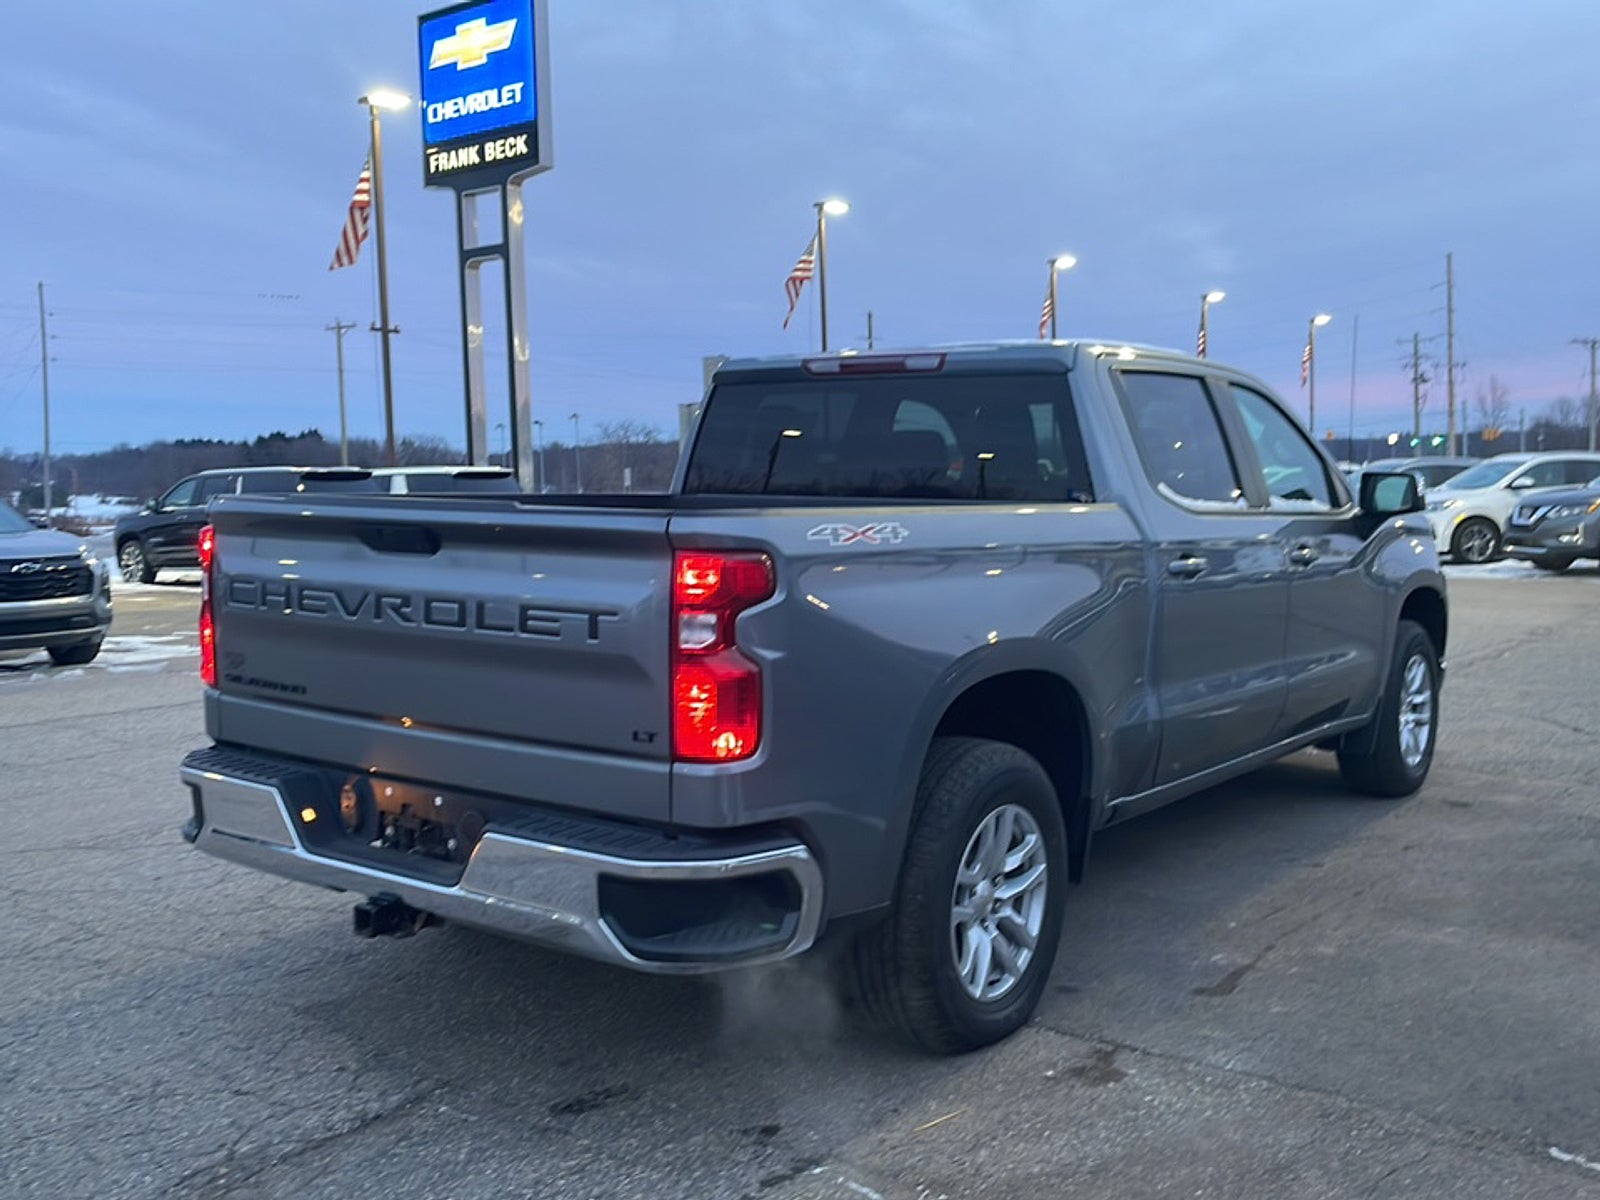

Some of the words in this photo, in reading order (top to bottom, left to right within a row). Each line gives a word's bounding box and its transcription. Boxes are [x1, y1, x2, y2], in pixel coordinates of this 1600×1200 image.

[427, 82, 524, 123] CHEVROLET
[428, 145, 480, 173] FRANK
[484, 134, 528, 162] BECK
[227, 579, 620, 644] CHEVROLET
[632, 730, 658, 744] LT
